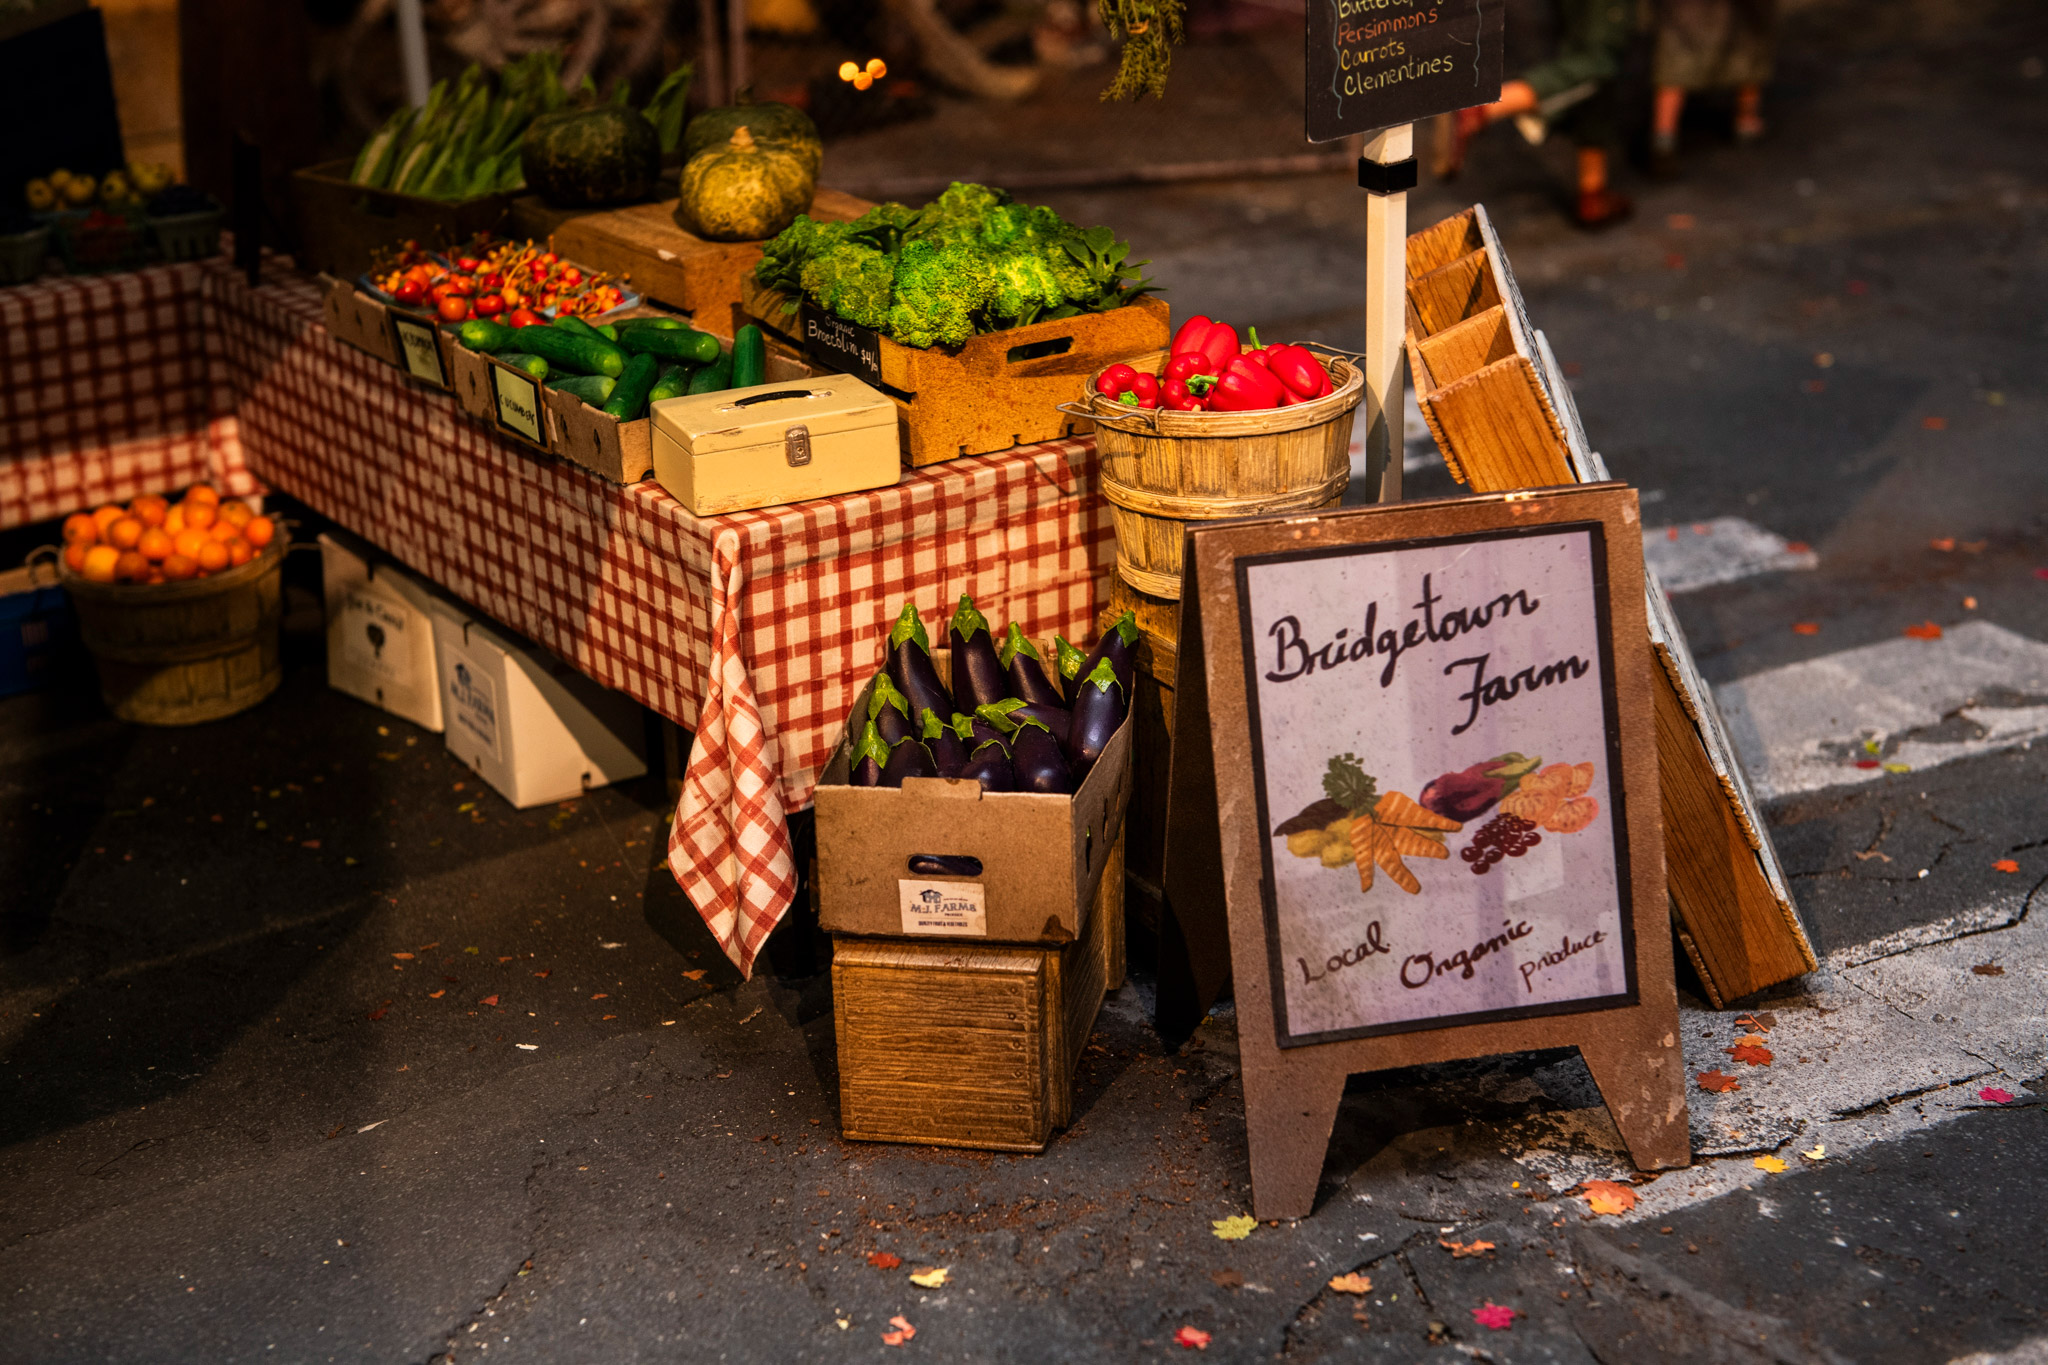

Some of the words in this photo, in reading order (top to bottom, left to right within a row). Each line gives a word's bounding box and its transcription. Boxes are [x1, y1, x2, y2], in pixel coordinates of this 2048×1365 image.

[1338, 8, 1438, 46] Persimmons
[1341, 38, 1405, 71] Carrots
[1344, 55, 1453, 96] Clementines
[825, 315, 855, 337] Organic
[1265, 572, 1540, 688] Bridgetown
[1443, 652, 1590, 736] Farm
[934, 902, 977, 913] FARMS
[1297, 920, 1391, 986] Local
[1399, 919, 1534, 990] Organic
